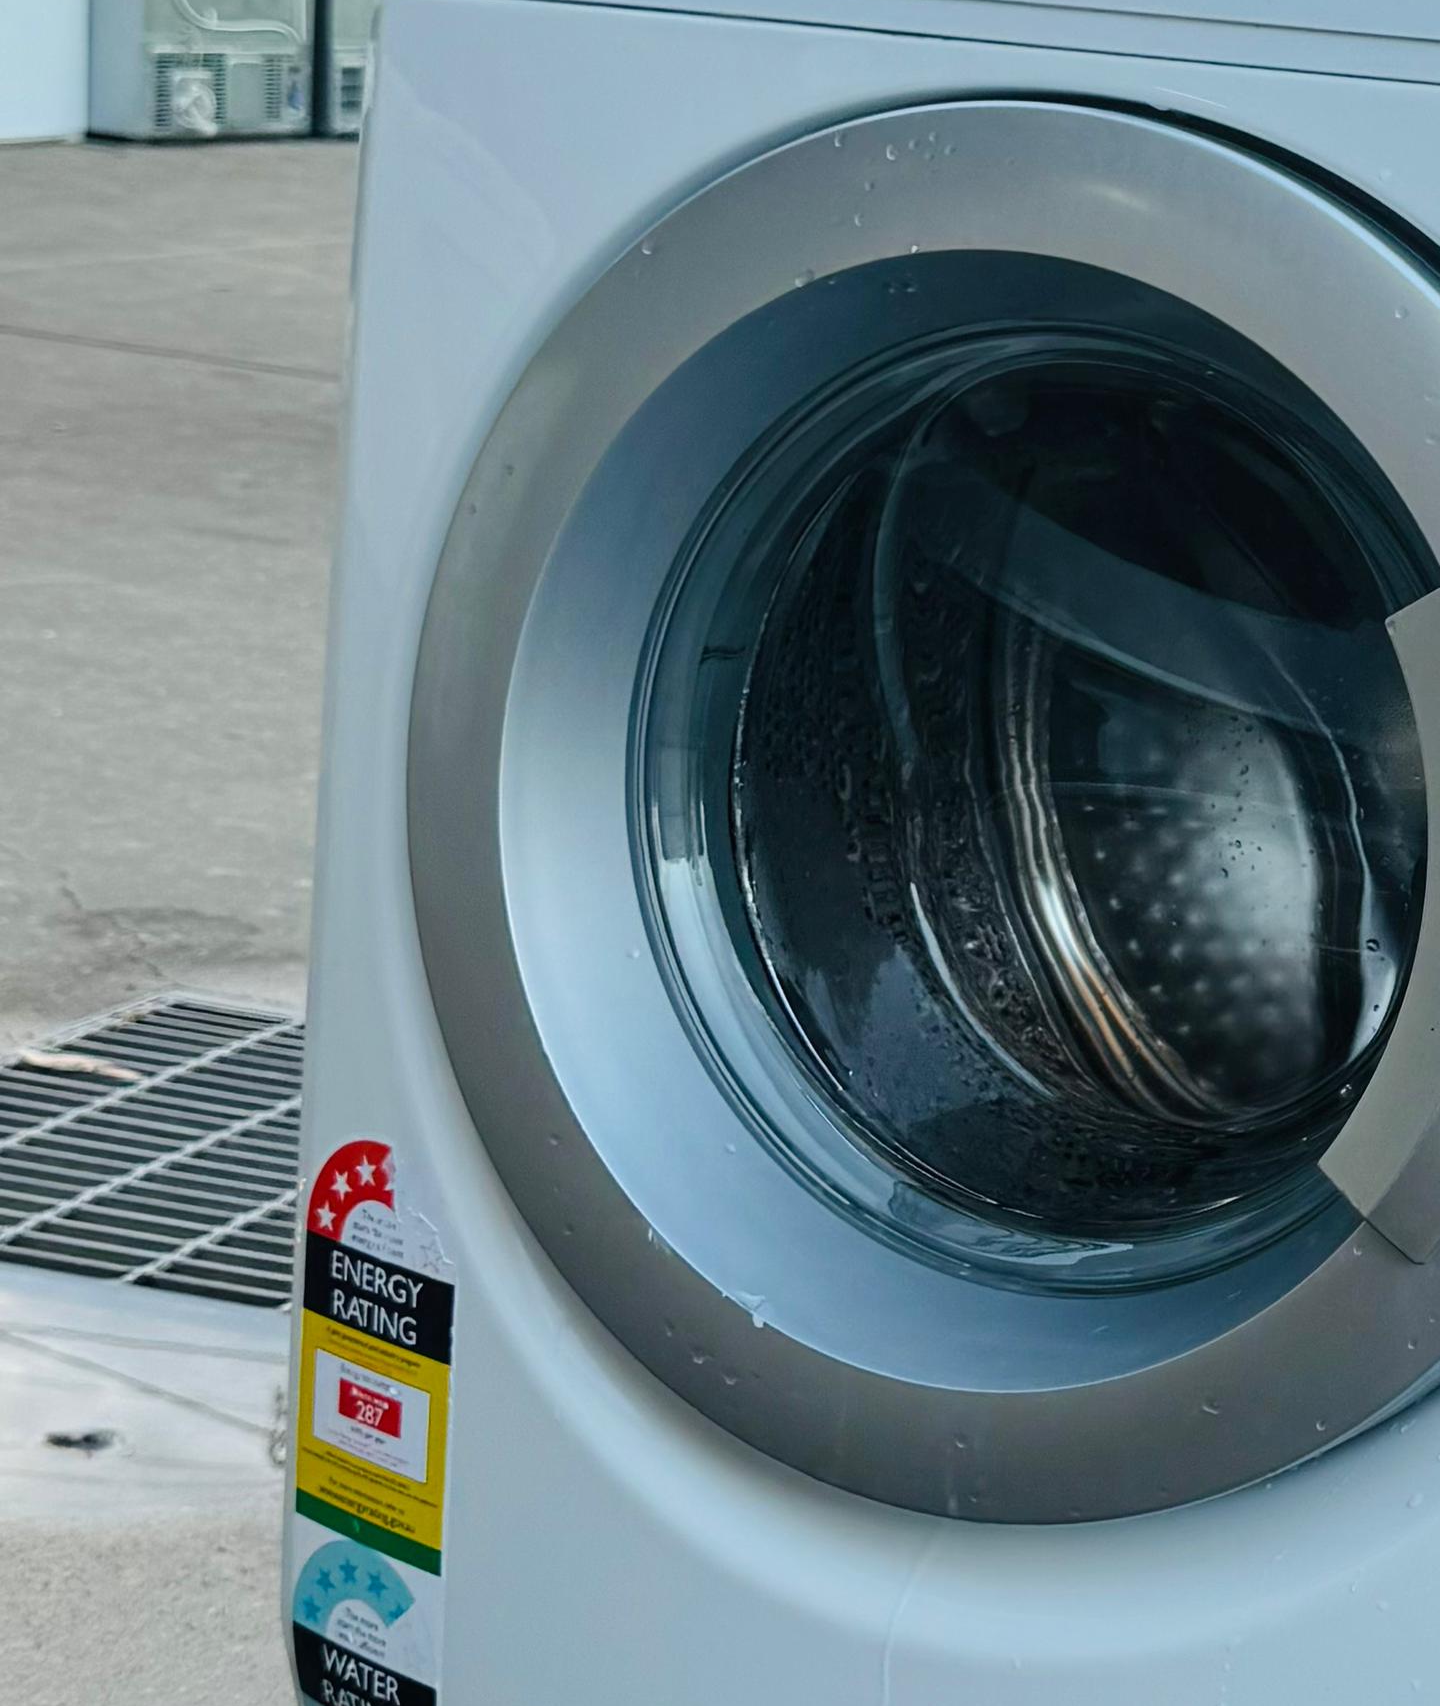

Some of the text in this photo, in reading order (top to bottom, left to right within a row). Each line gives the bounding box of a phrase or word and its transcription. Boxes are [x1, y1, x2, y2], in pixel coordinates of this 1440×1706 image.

[331, 1250, 424, 1308] ENERGY
[332, 1289, 418, 1345] RATING
[355, 1400, 384, 1427] 287
[322, 1643, 401, 1706] WATER
